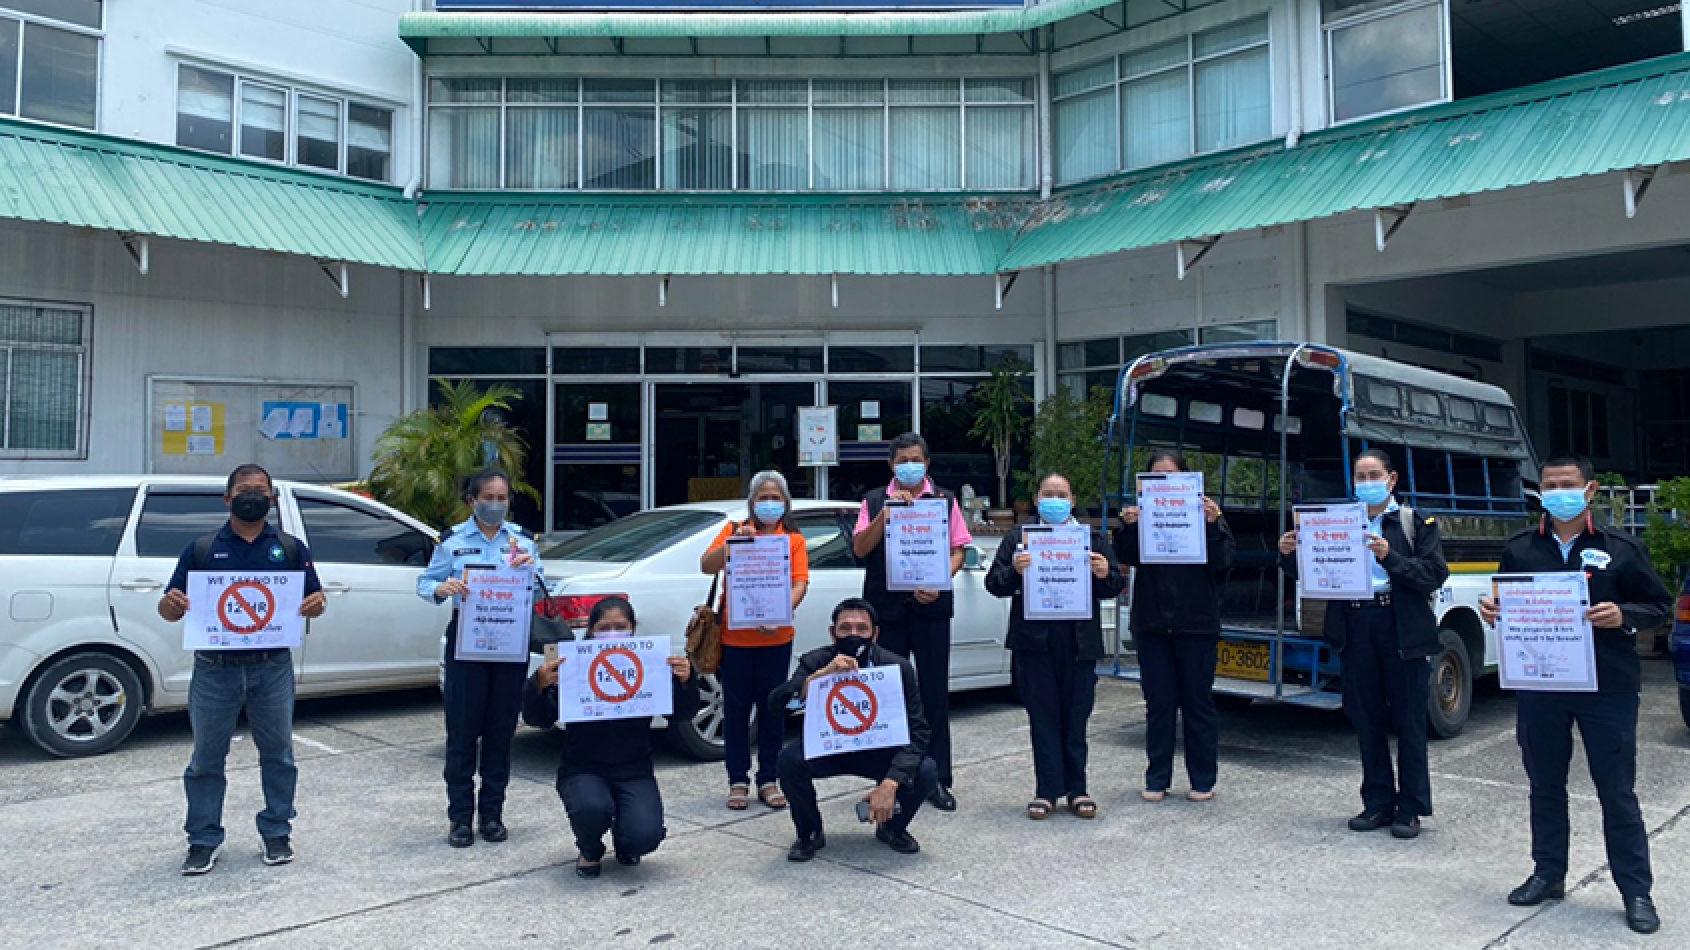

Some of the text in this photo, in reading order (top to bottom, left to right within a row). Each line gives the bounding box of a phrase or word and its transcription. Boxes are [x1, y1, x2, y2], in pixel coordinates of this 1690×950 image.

[207, 575, 225, 585] WE
[273, 575, 289, 585] TO
[227, 602, 242, 614] 12
[576, 645, 592, 655] WE
[640, 640, 655, 650] TO
[598, 670, 613, 683] 12
[870, 672, 885, 682] TO
[833, 703, 849, 715] 12
